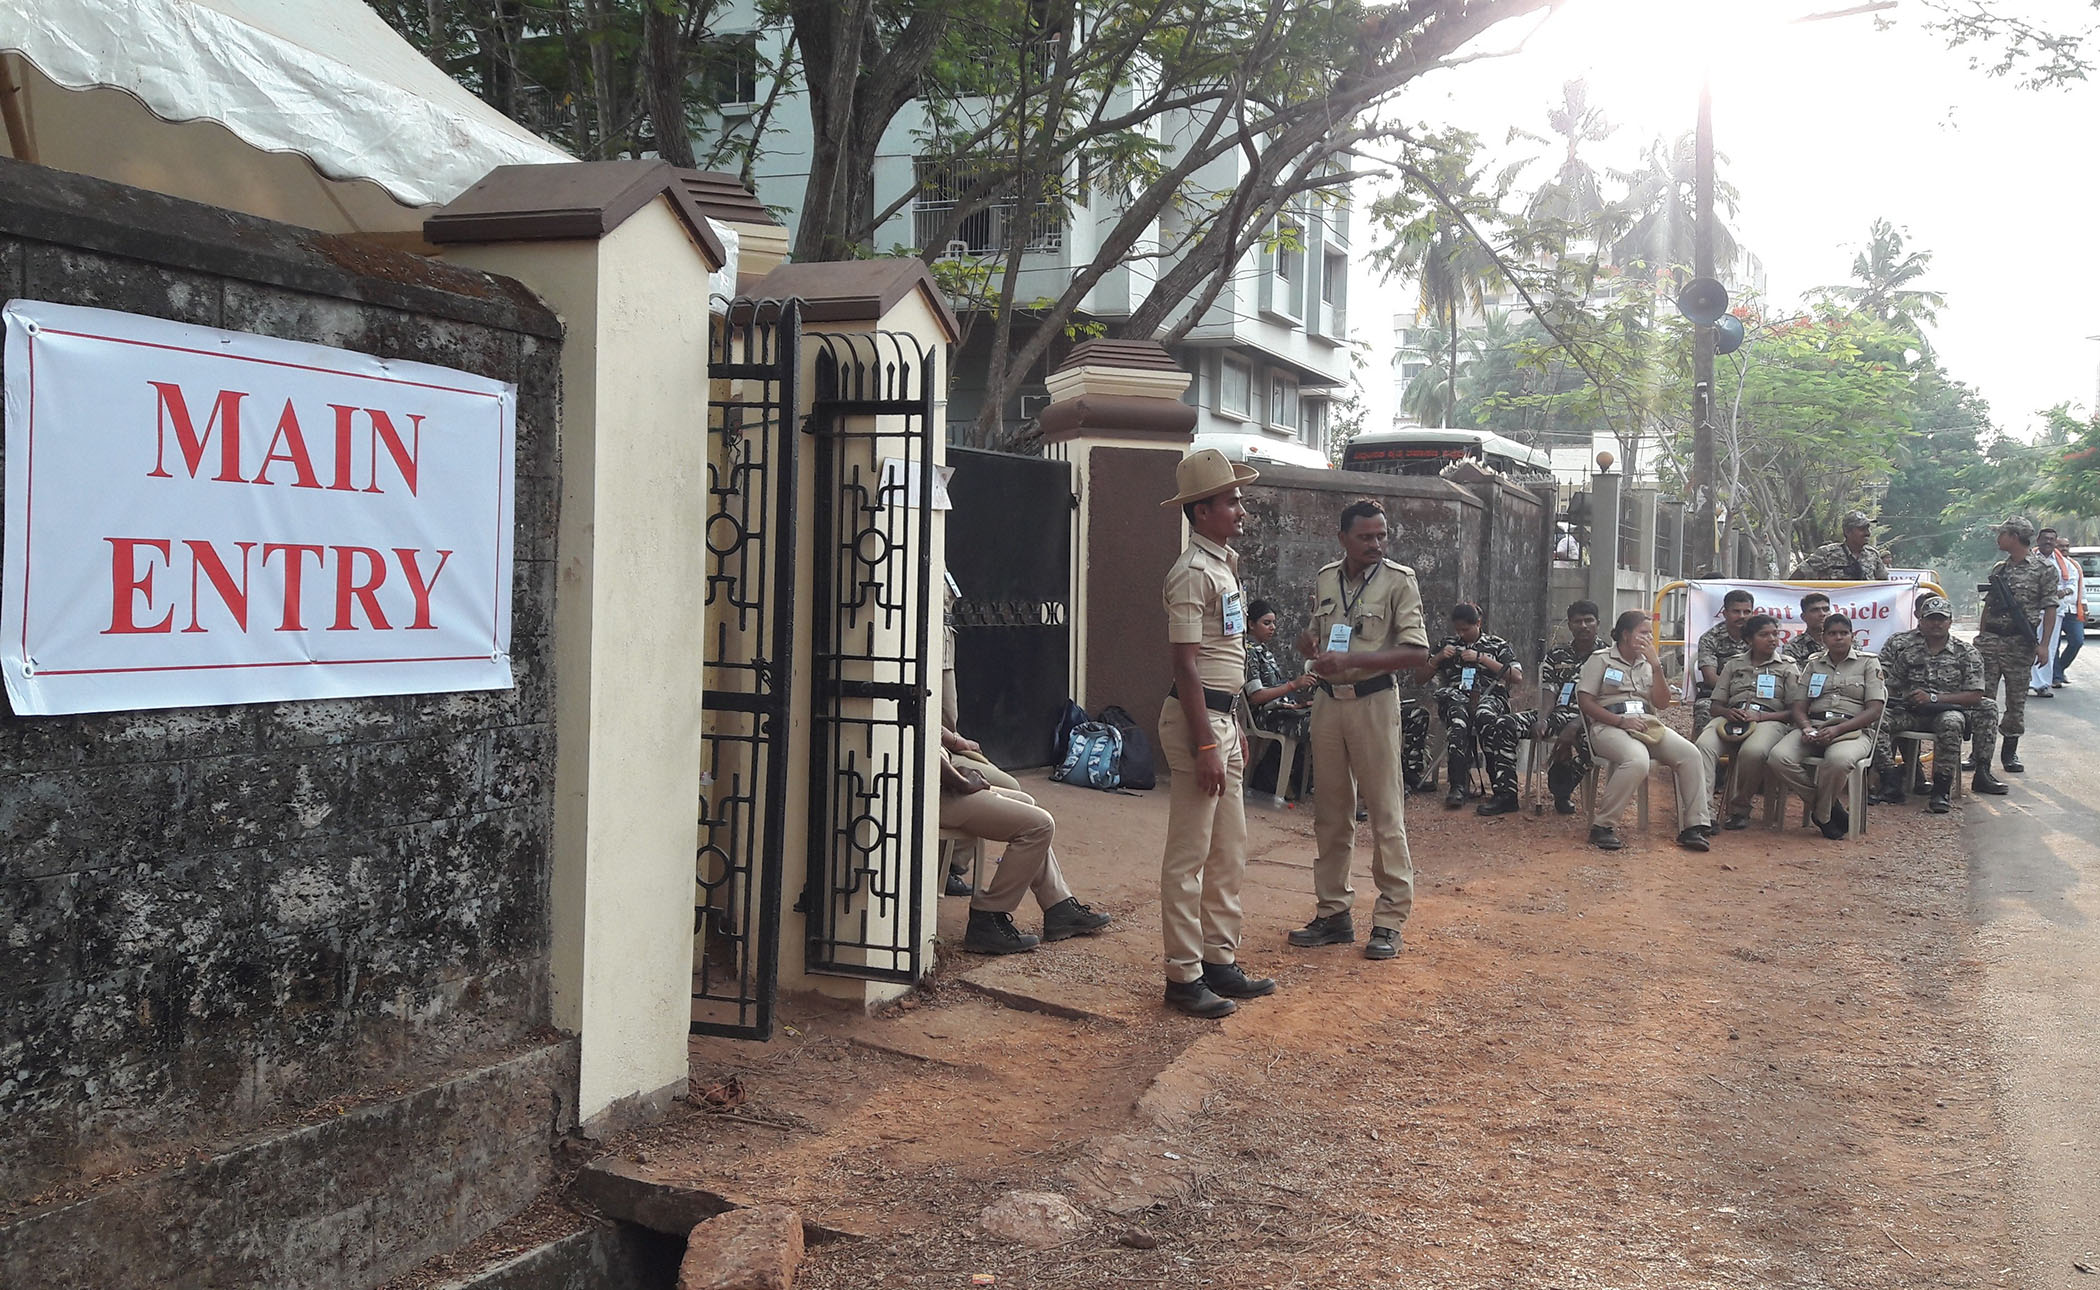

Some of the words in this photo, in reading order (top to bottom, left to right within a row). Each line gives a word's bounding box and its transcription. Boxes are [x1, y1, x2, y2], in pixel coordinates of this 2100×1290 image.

[147, 380, 426, 498] MAIN
[100, 537, 453, 634] ENTRY
[1713, 604, 1794, 619] Aent
